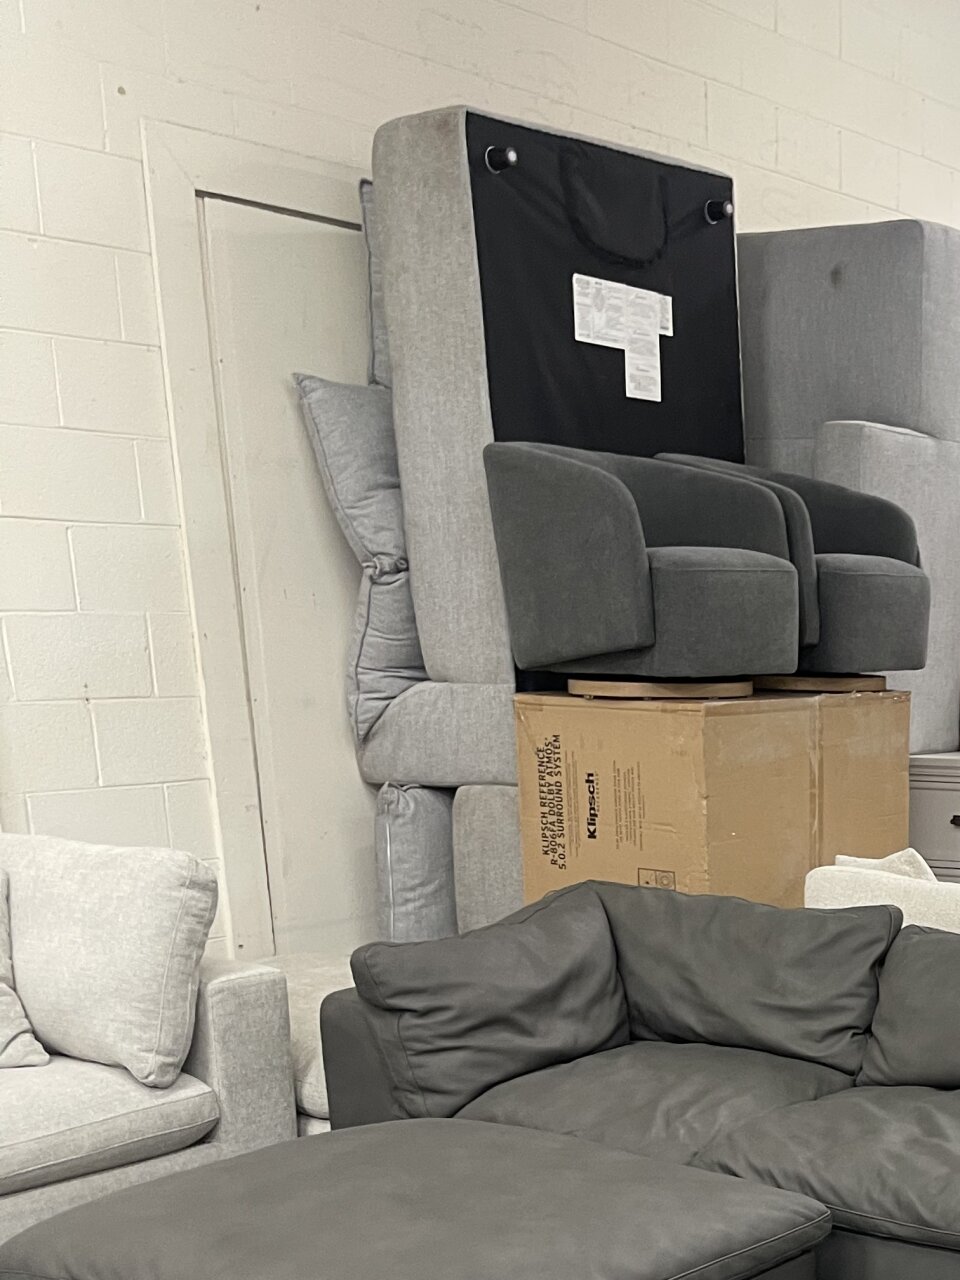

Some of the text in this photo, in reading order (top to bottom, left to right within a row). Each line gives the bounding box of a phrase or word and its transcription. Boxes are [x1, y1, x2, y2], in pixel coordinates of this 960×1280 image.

[537, 747, 550, 855] KLIPSCH REFERENCE
[546, 781, 556, 816] DOLBY
[552, 734, 567, 870] 5.0.2 SURROUND SYSTEM
[585, 773, 598, 839] Klipsch
[549, 821, 558, 865] R-806FA
